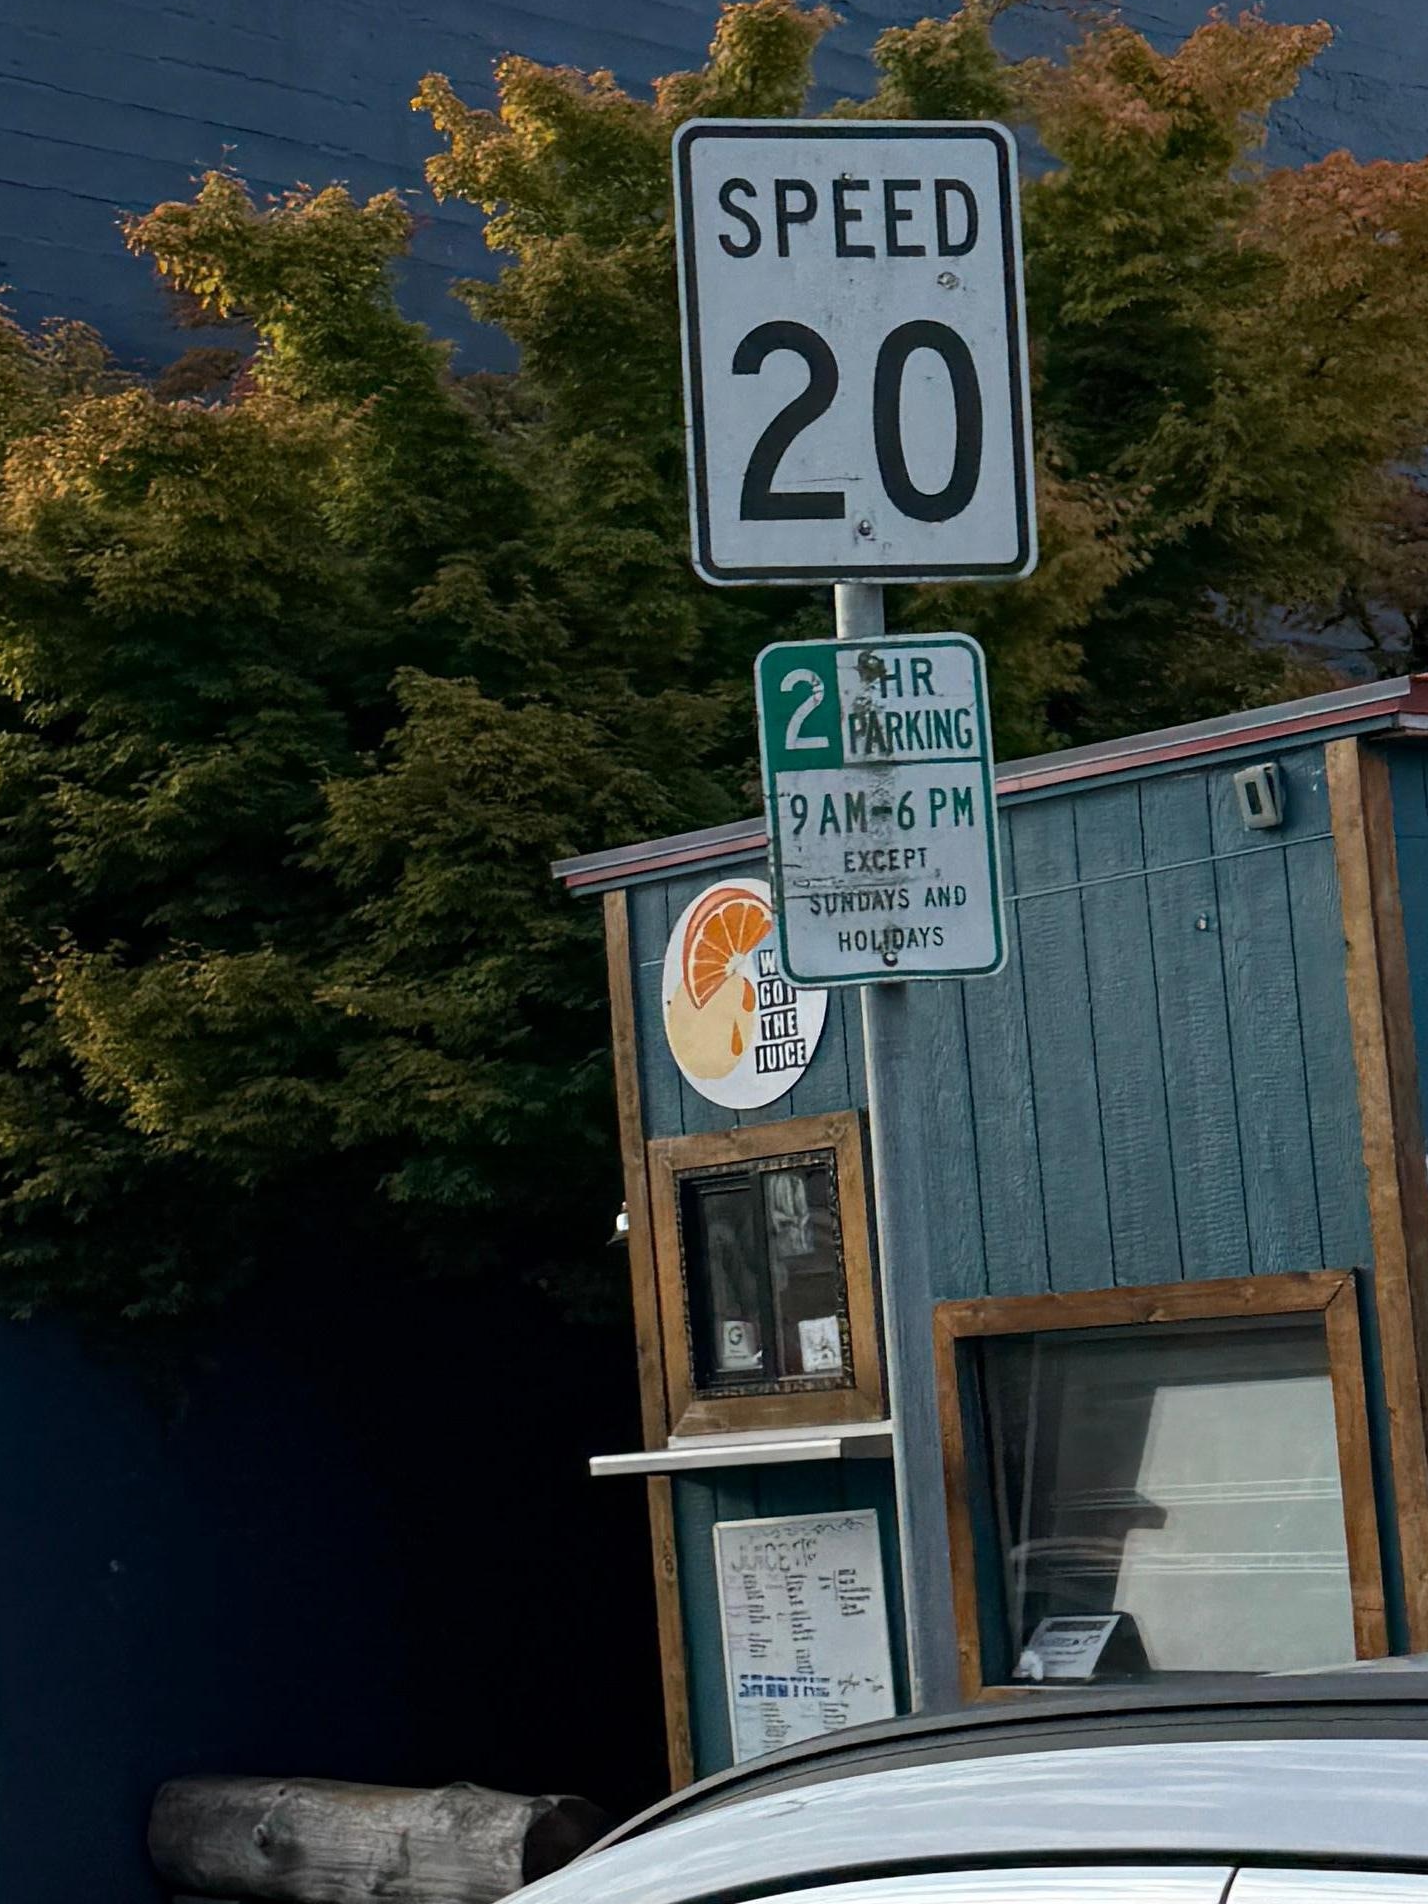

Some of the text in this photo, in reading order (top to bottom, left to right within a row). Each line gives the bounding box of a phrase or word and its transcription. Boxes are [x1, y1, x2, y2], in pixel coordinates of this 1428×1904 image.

[718, 177, 979, 258] SPEED
[732, 319, 983, 522] 20
[780, 657, 935, 750] 2 HR
[848, 707, 973, 755] PARKING
[844, 847, 928, 873] EXCEPT
[810, 884, 967, 916] SUNDAYS AND
[838, 926, 945, 953] HOLIDAYS
[762, 1010, 796, 1040] THE
[758, 1041, 805, 1072] JUICE
